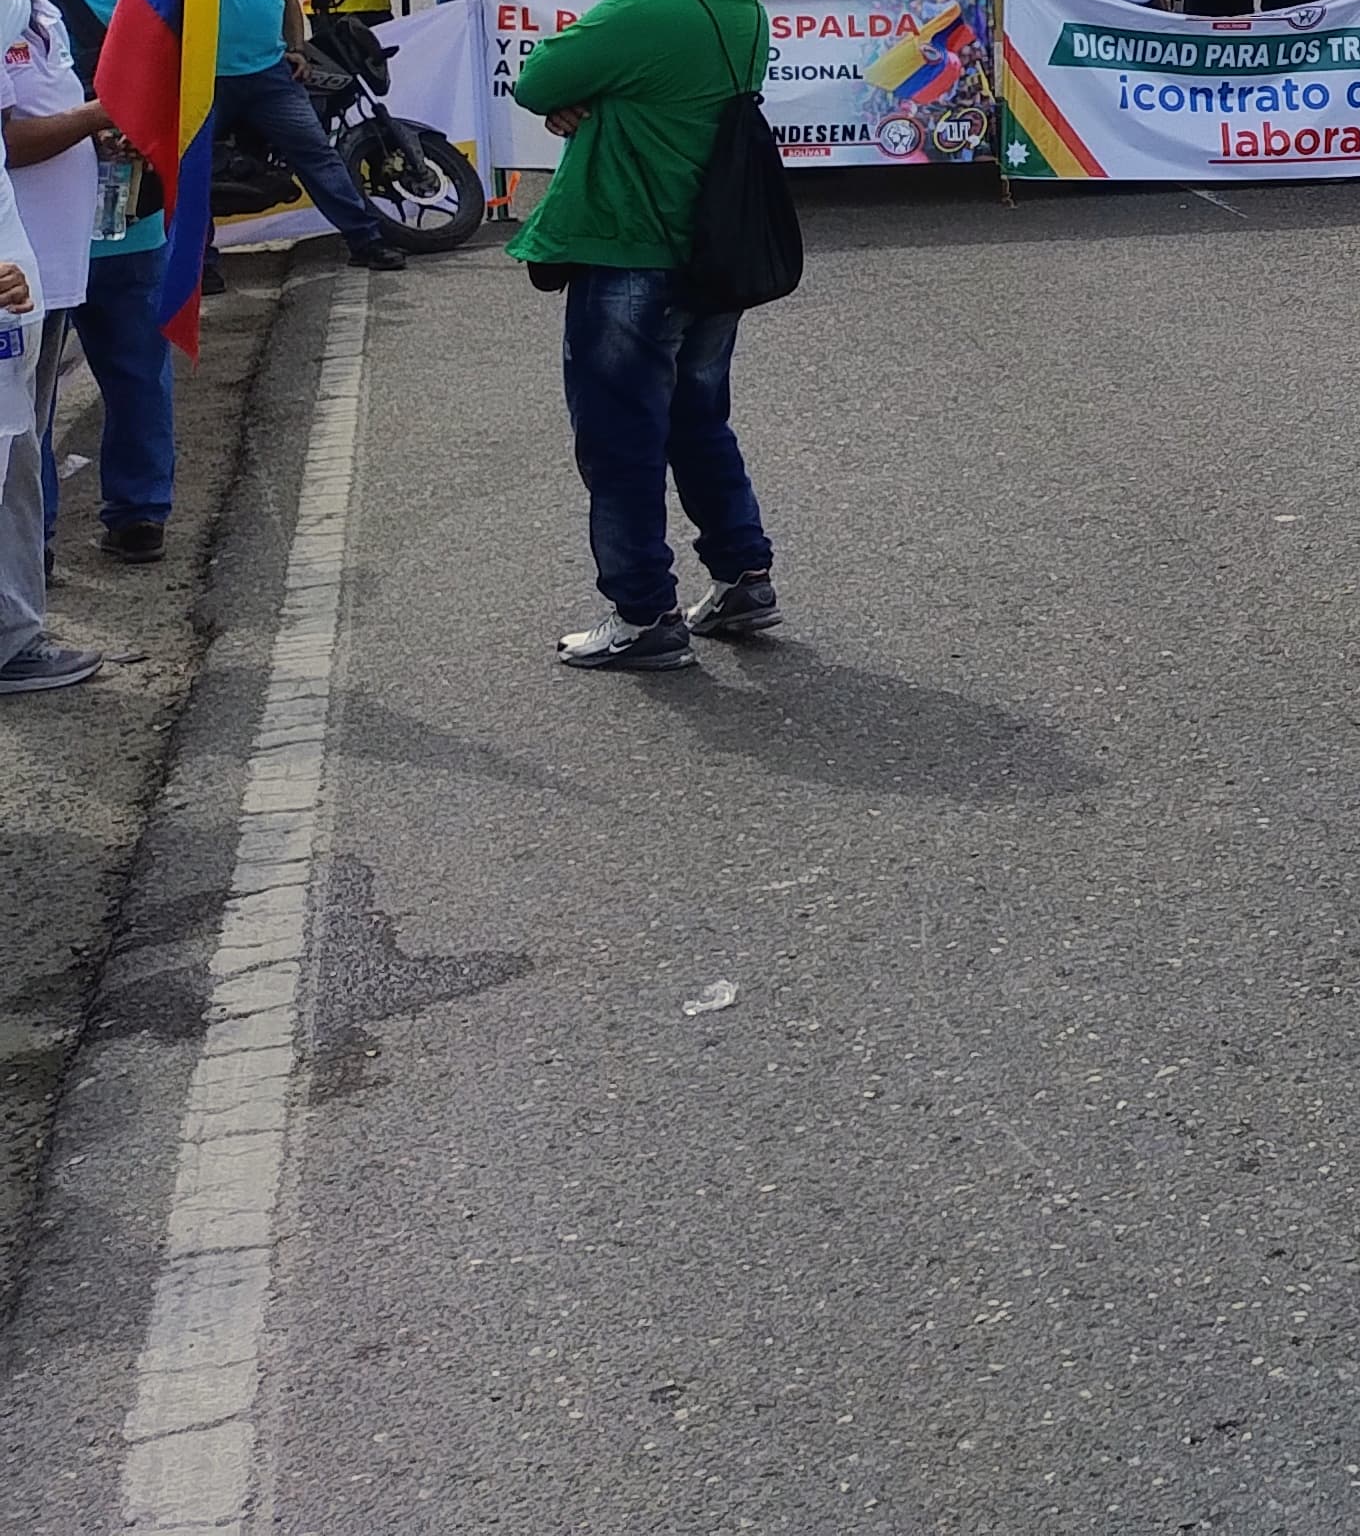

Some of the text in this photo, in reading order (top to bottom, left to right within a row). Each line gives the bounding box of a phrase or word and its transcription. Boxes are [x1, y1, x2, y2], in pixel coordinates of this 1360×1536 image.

[496, 4, 540, 32] EL
[771, 13, 922, 41] SPALDA
[495, 38, 511, 56] Y
[1072, 32, 1198, 66] DIGNIDAD
[1204, 43, 1270, 68] PARA
[1275, 39, 1321, 65] LOS
[493, 59, 512, 76] A
[768, 64, 864, 81] ESIONAL
[773, 123, 871, 145] NDESENA
